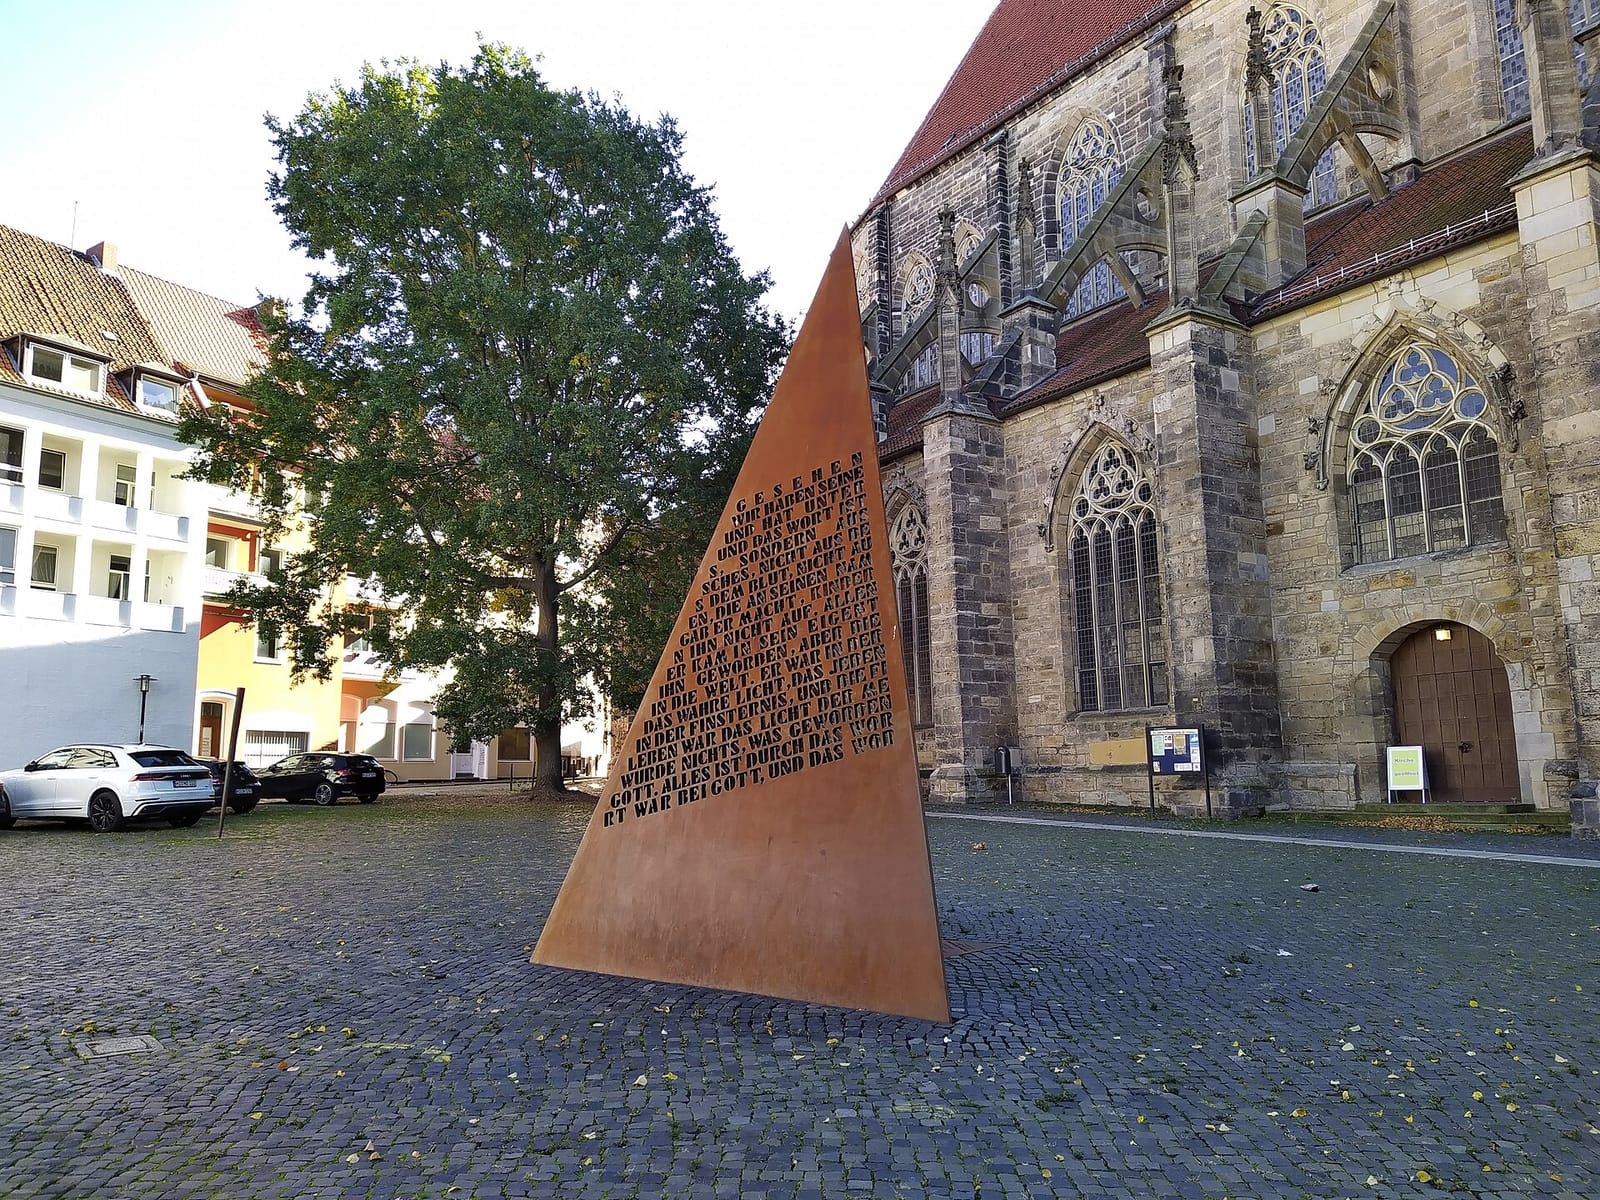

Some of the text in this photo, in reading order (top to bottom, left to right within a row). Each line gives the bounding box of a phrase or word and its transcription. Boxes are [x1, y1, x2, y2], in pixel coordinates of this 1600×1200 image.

[724, 479, 864, 544] UND HAT UNTER
[732, 465, 864, 528] WIR HABEN SEINE
[718, 540, 748, 561] UND
[752, 526, 783, 548] DAS
[786, 506, 834, 534] WORT
[739, 527, 816, 568] SONDERN
[759, 545, 807, 575] NICHT
[812, 532, 843, 555] AUS
[680, 626, 709, 647] GAB
[714, 617, 733, 635] ER
[810, 567, 874, 601] KINDER
[695, 598, 704, 613] S
[710, 584, 744, 607] DEM
[796, 546, 846, 576] NICHT
[715, 599, 741, 620] DIE
[747, 589, 767, 609] AN
[769, 567, 828, 601] SEINEN
[659, 678, 685, 699] IHN
[799, 625, 842, 653] ABER
[667, 596, 879, 682] ER KAM IN SEIN EIGENT
[674, 649, 684, 664] N
[690, 637, 717, 659] IHN
[723, 617, 773, 647] NICHT
[636, 735, 651, 753] IN
[654, 725, 685, 747] DER
[797, 679, 832, 701] UND
[644, 713, 673, 735] DAS
[676, 694, 730, 724] WAHRE
[791, 664, 824, 687] DAS
[651, 699, 667, 717] IN
[671, 689, 697, 711] DIE
[760, 662, 782, 681] ER
[785, 649, 821, 672] WAR
[621, 759, 676, 789] WURDE
[748, 726, 782, 750] WAS
[789, 693, 892, 738] GEWORDEN
[628, 743, 678, 772] LEBEN
[681, 731, 716, 754] WAR
[721, 719, 752, 743] DAS
[760, 701, 811, 730] LICHT
[817, 688, 853, 713] DER
[661, 765, 711, 794] ALLES
[715, 755, 742, 778] IST
[746, 737, 804, 769] DURCH
[809, 725, 843, 750] DAS
[604, 807, 626, 827] RT
[634, 794, 671, 818] WAR
[678, 783, 707, 806] BEI
[768, 755, 804, 779] UND
[809, 743, 844, 768] DAS
